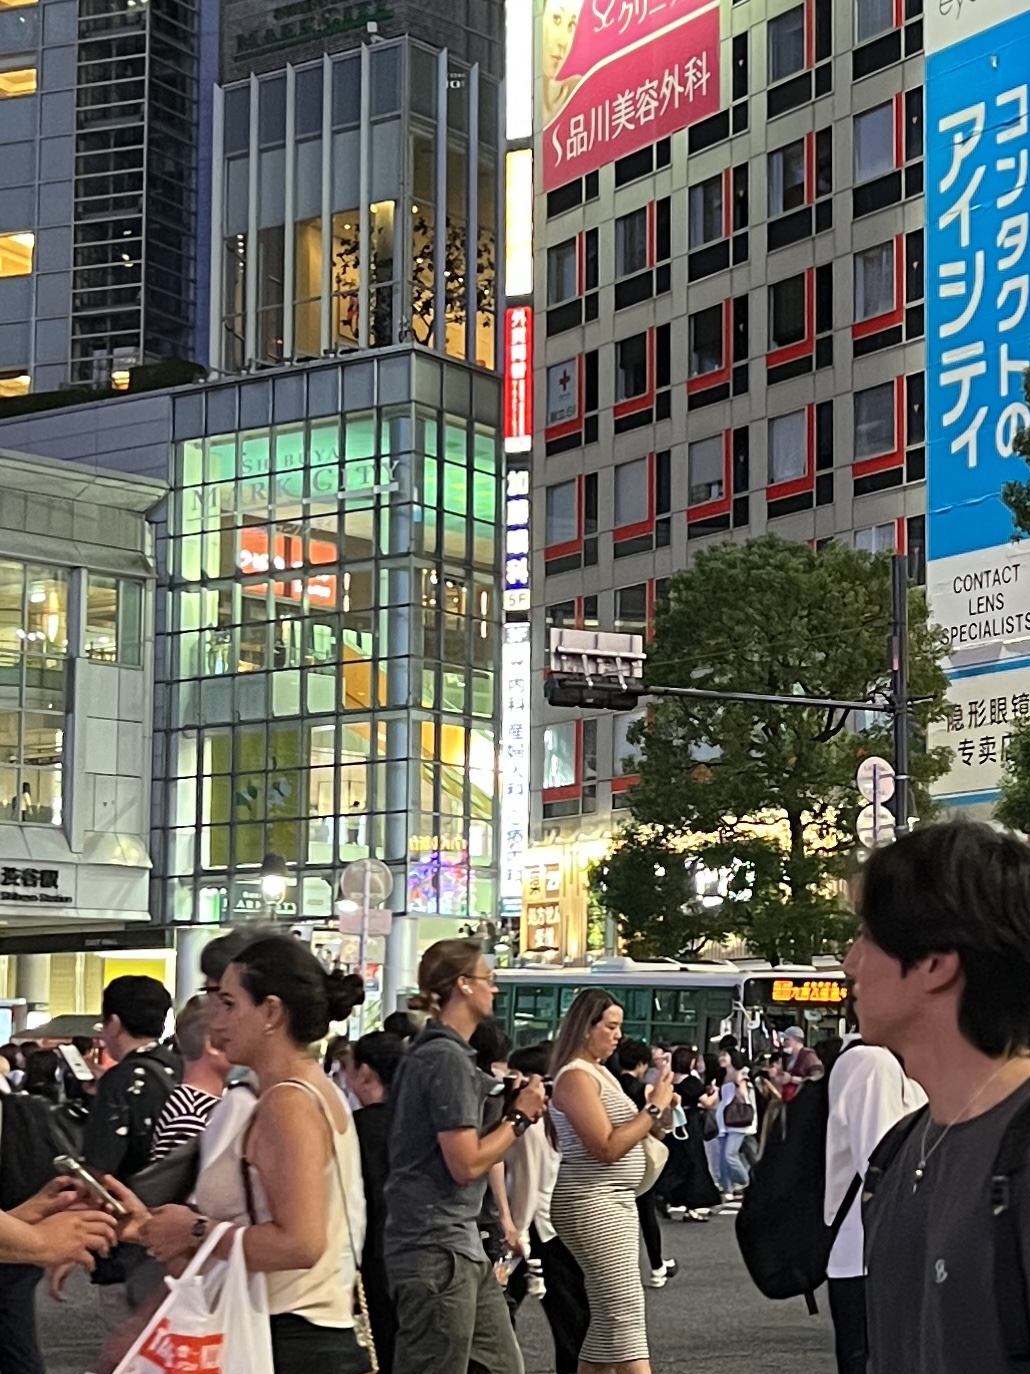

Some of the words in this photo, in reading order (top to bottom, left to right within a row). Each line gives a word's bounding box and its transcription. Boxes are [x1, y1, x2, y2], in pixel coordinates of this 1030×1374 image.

[566, 51, 711, 160] 品川美容外科
[939, 102, 989, 468] アイシティ
[953, 563, 1021, 594] CONTACT
[509, 593, 526, 607] 5F
[968, 592, 1005, 616] LENS
